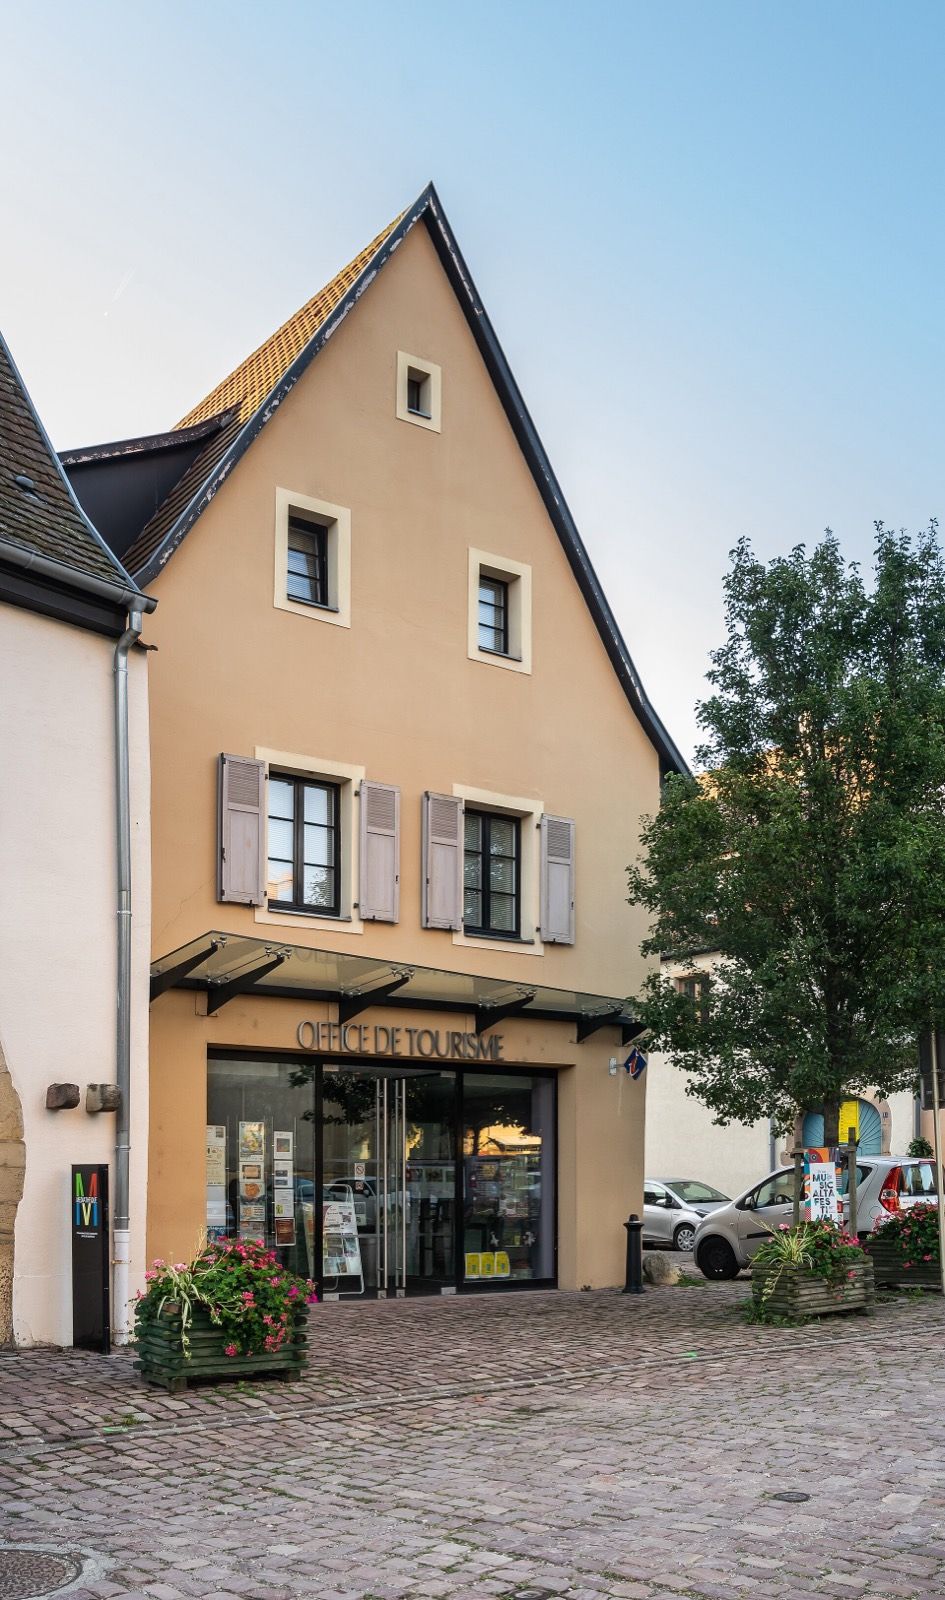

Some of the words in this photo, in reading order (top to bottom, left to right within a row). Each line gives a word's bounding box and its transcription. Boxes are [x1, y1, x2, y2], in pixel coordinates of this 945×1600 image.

[297, 1020, 369, 1053] OFFICE
[374, 1025, 401, 1056] DE
[405, 1028, 504, 1060] TOURISME
[813, 1174, 827, 1182] MU
[813, 1189, 835, 1198] ALTA
[820, 1206, 829, 1214] TI
